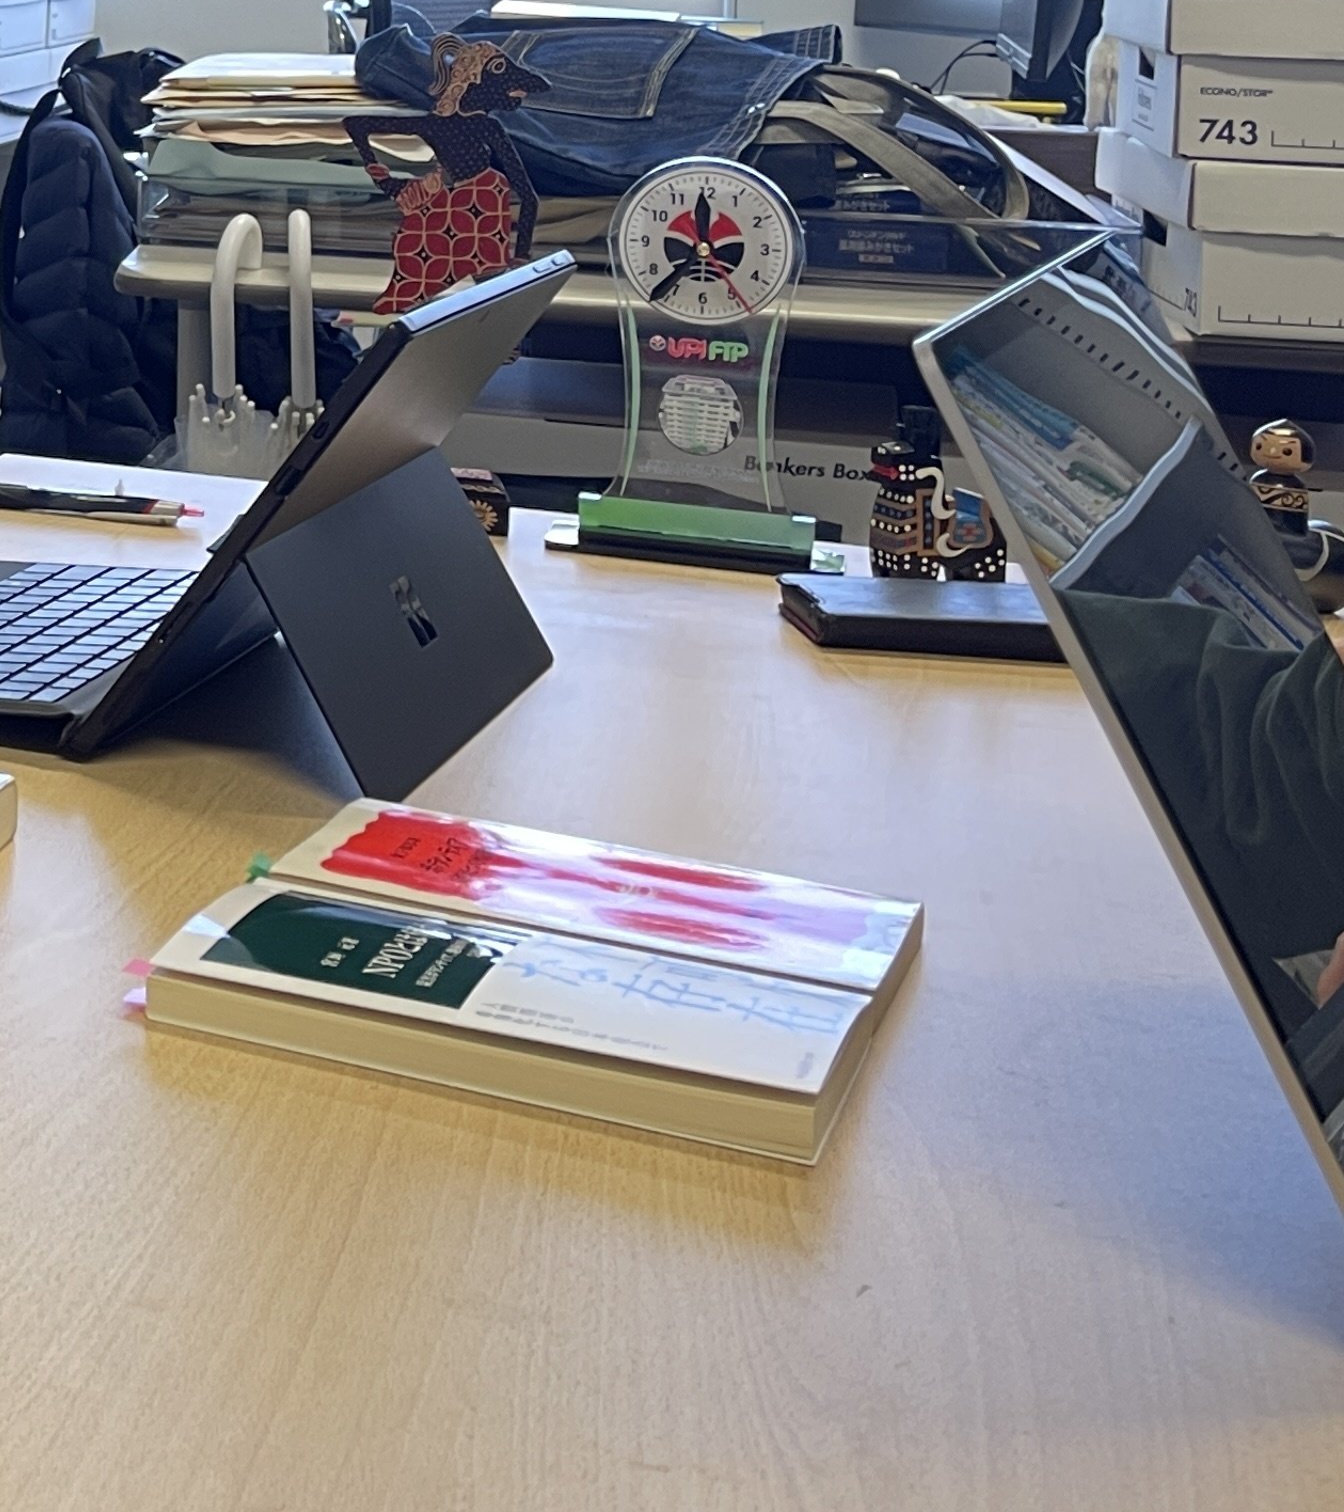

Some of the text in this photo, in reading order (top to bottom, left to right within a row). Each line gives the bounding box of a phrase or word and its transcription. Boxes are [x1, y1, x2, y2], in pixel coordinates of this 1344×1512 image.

[1197, 118, 1259, 146] 743
[670, 193, 685, 206] 11
[731, 195, 738, 207] 1
[651, 209, 668, 223] 10
[752, 216, 763, 229] 2
[641, 235, 650, 248] 9
[759, 243, 770, 257] 3
[648, 263, 659, 276] 8
[750, 269, 760, 283] 4
[698, 291, 708, 305] 6
[666, 336, 750, 364] UPI FTP
